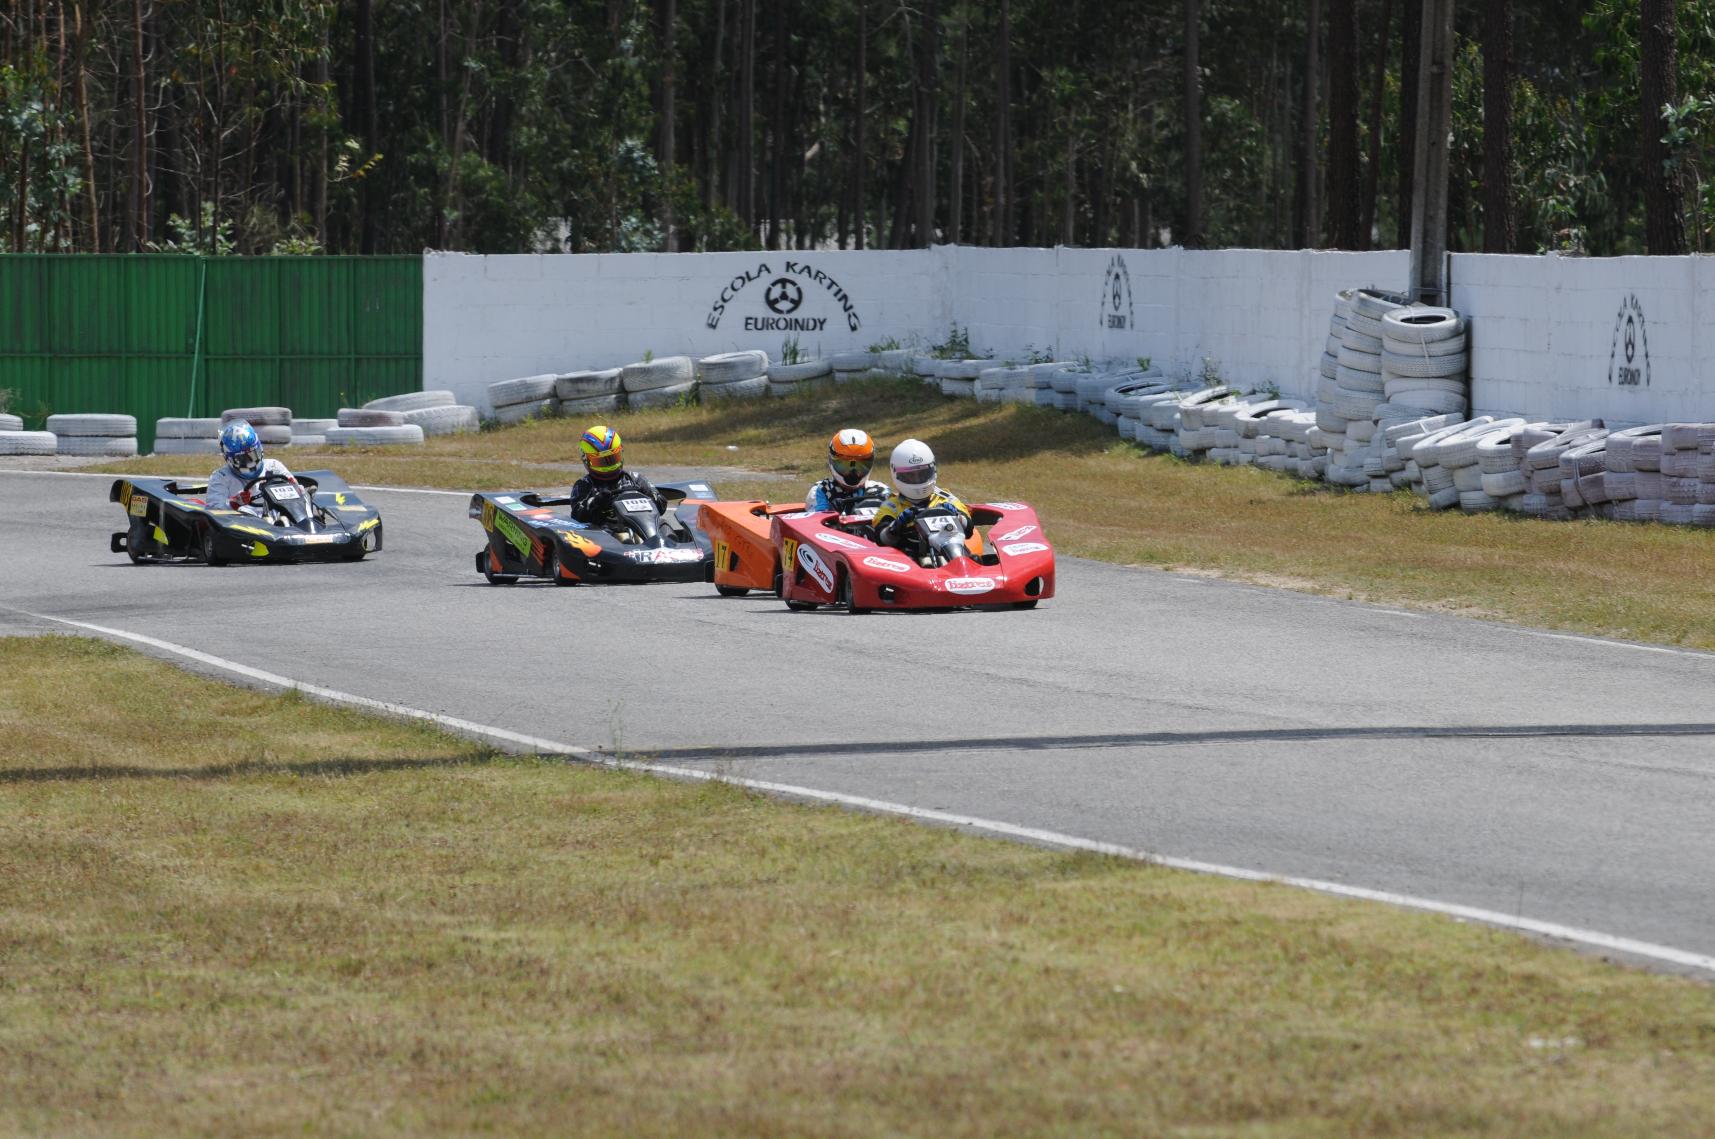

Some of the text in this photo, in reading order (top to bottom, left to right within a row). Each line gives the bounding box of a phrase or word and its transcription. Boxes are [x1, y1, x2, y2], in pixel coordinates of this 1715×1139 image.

[706, 261, 862, 332] ESCOLA KARTING
[743, 316, 827, 331] EUROINDY
[715, 542, 728, 570] 17
